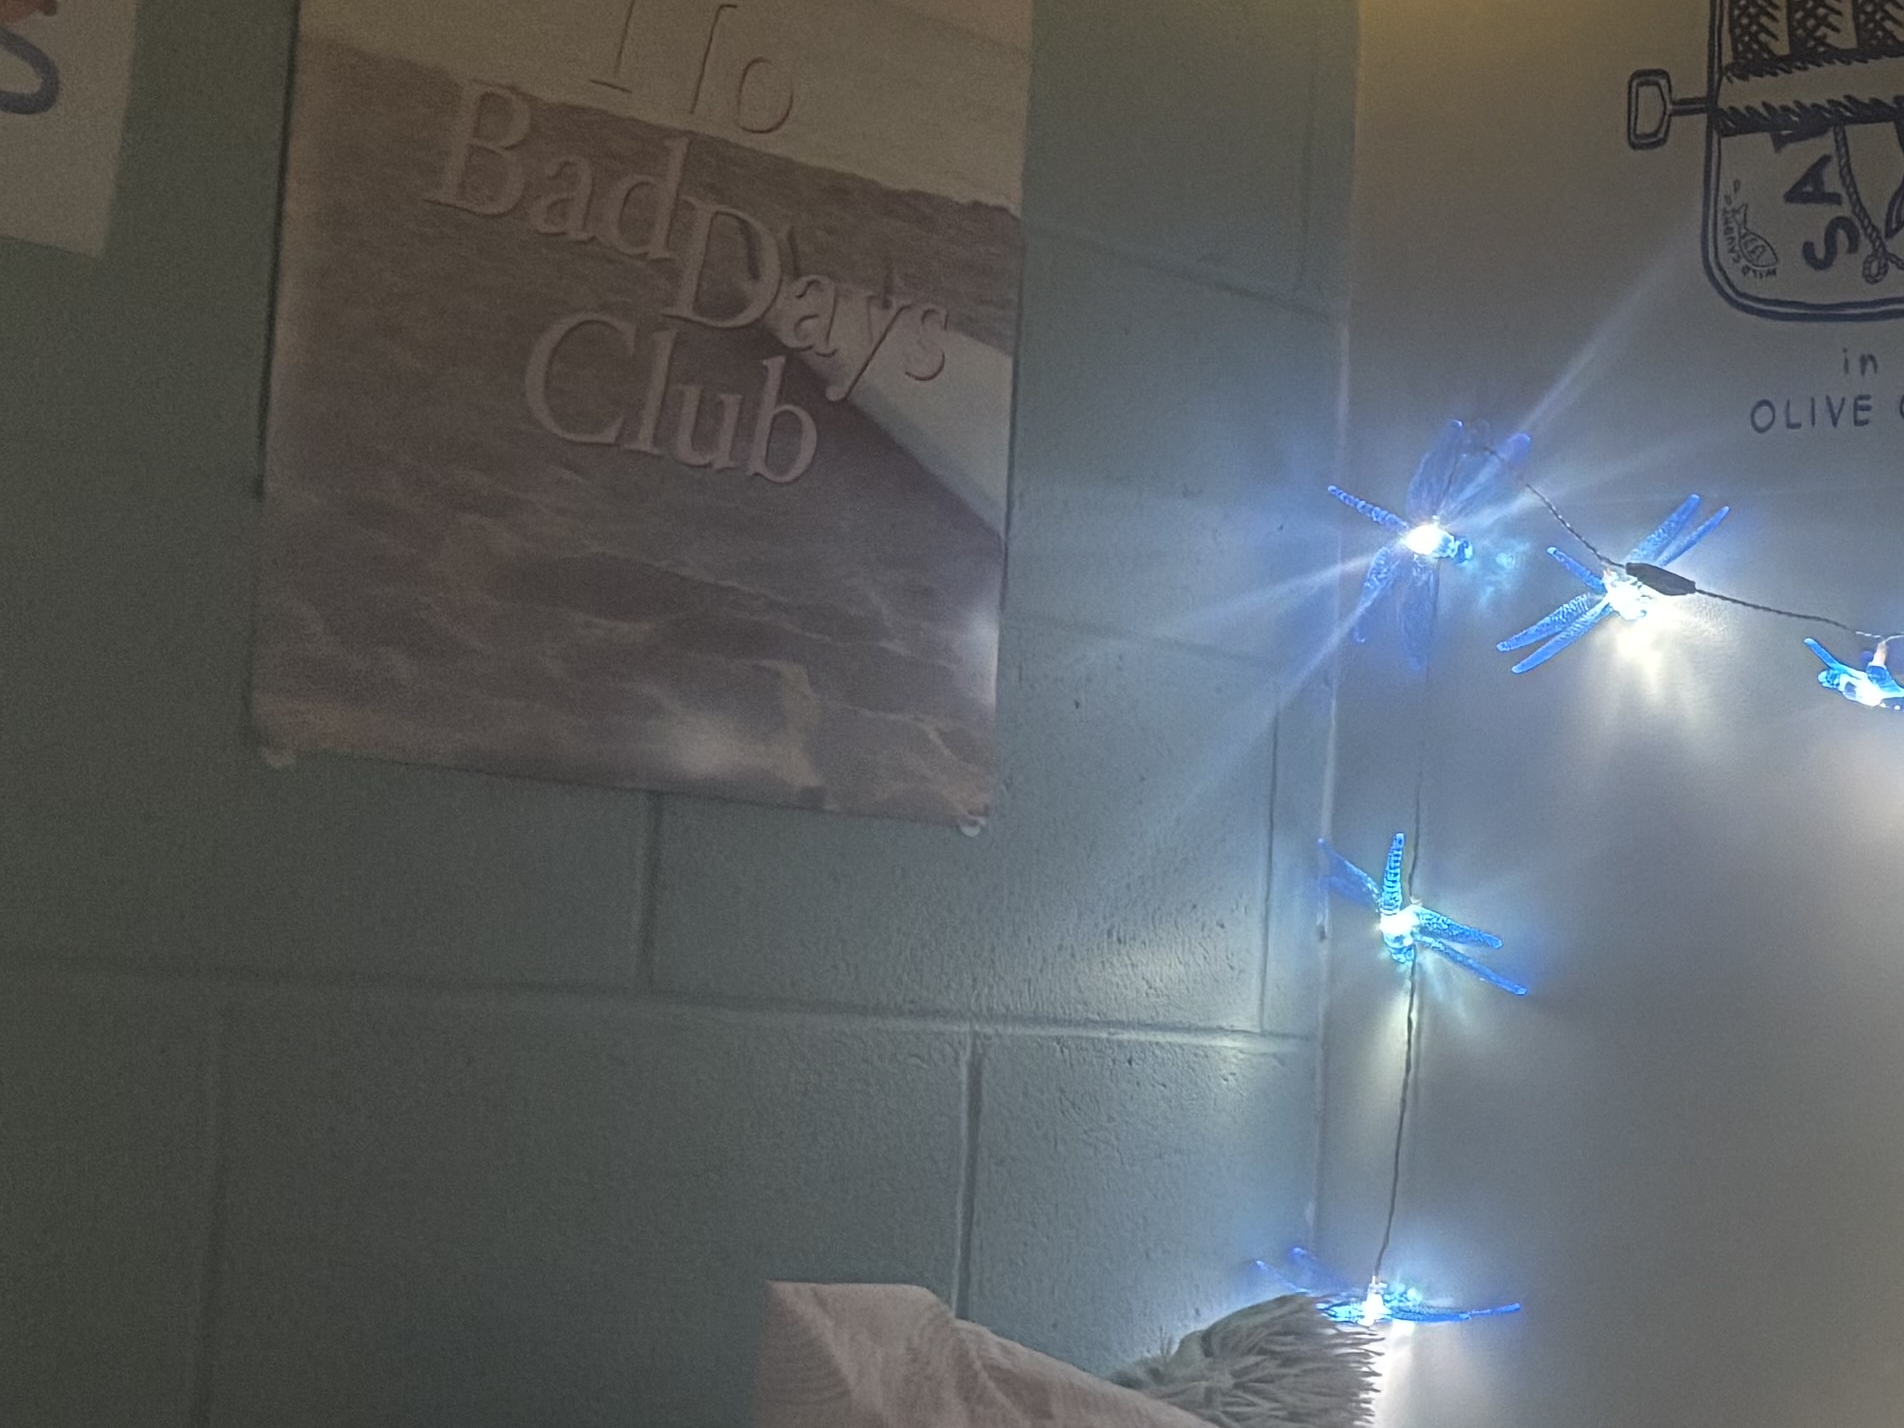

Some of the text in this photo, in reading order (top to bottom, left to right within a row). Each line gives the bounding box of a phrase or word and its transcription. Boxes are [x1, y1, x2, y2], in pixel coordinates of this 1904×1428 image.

[422, 76, 952, 403] Bad Days
[523, 310, 818, 484] Club
[1749, 393, 1873, 435] OLIVE
[1841, 346, 1879, 378] in
